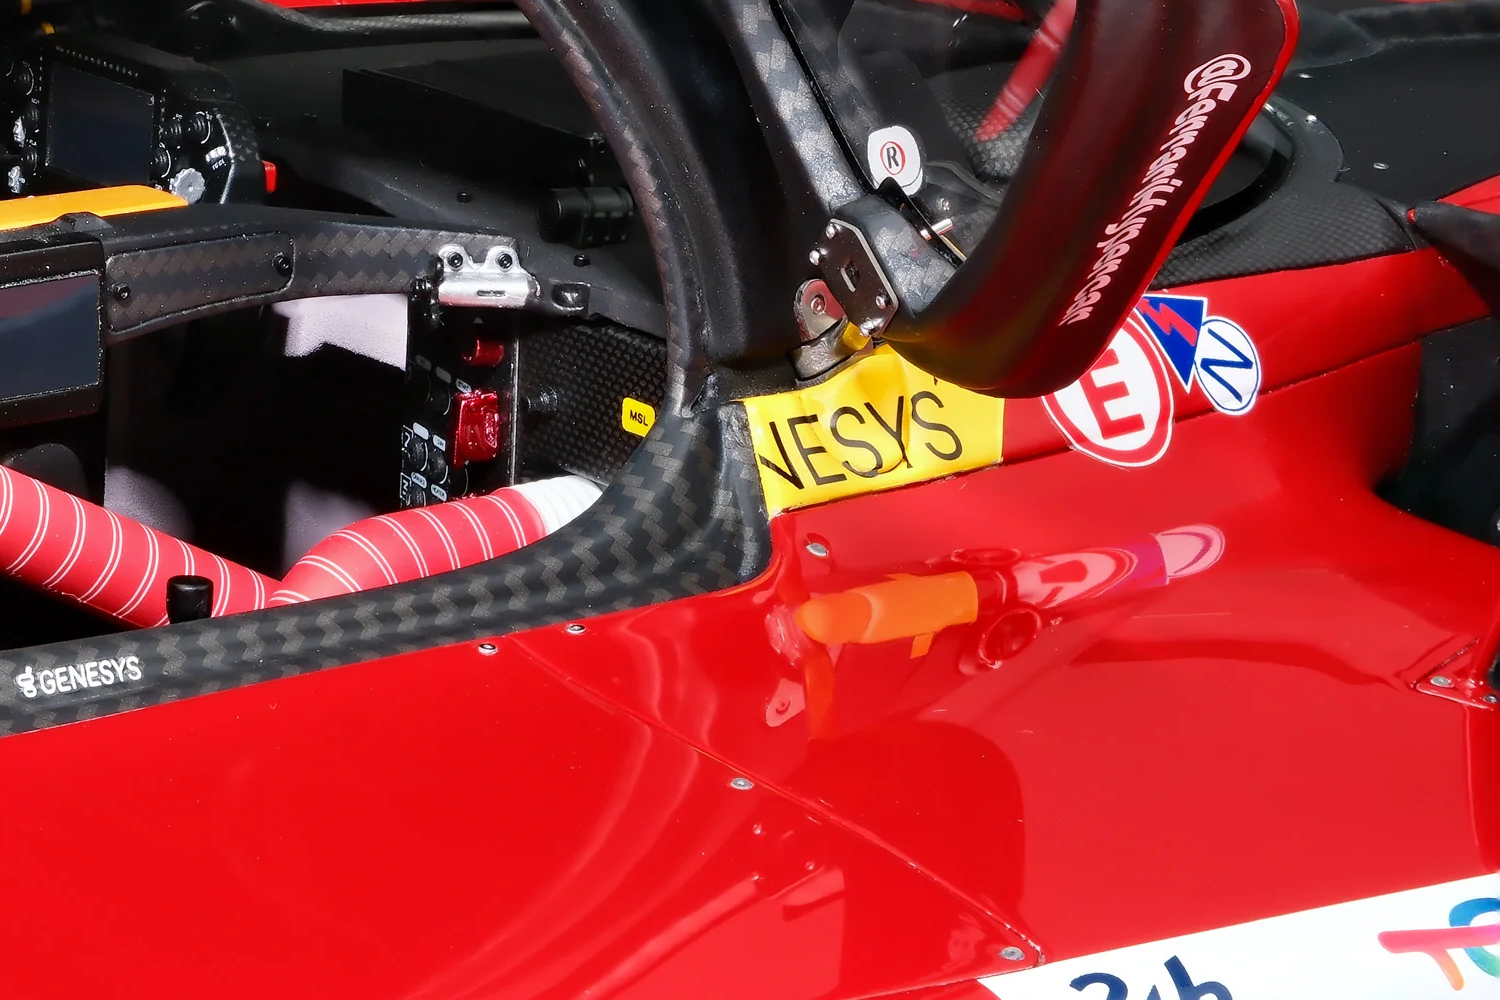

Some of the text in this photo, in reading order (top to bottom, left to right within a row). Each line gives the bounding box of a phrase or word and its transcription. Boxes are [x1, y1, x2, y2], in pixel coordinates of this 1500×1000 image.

[1078, 348, 1145, 440] E
[629, 409, 649, 427] MSL
[39, 655, 142, 695] GENESYS
